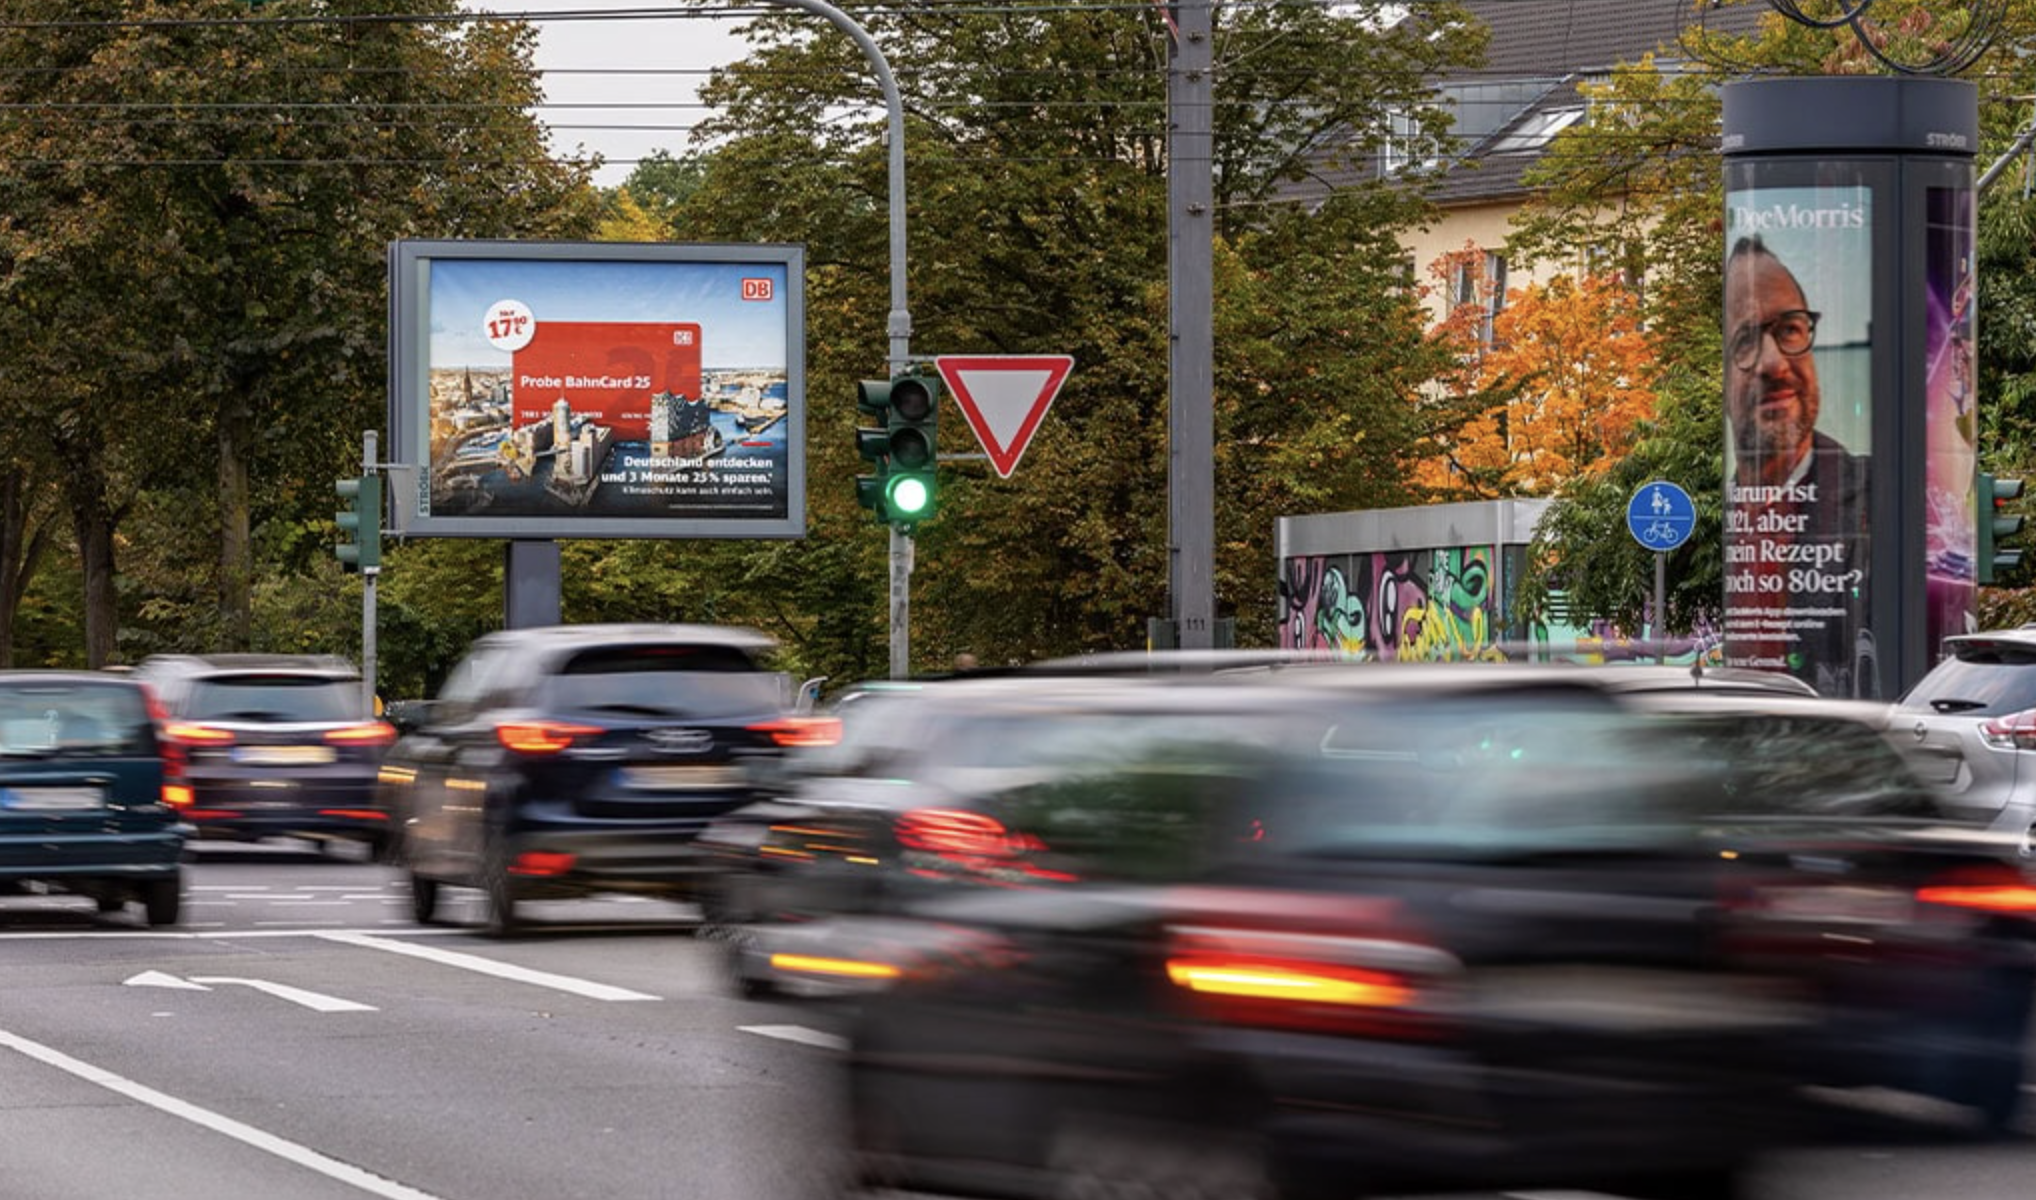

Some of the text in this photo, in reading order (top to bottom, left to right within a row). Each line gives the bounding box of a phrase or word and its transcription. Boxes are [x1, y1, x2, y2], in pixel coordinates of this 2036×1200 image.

[1737, 203, 1864, 229] DocMorris
[744, 280, 770, 298] DB
[489, 319, 511, 339] 17
[520, 375, 652, 389] Probe BahnCard 25
[623, 455, 774, 469] Deutschland entdecken
[601, 471, 625, 483] und
[629, 471, 638, 483] 3
[641, 471, 689, 483] Monate
[1787, 482, 1819, 503] ist
[1757, 508, 1810, 533] aber
[1760, 540, 1844, 568] Rezept
[1758, 574, 1784, 593] so
[1787, 569, 1863, 593] 80er?
